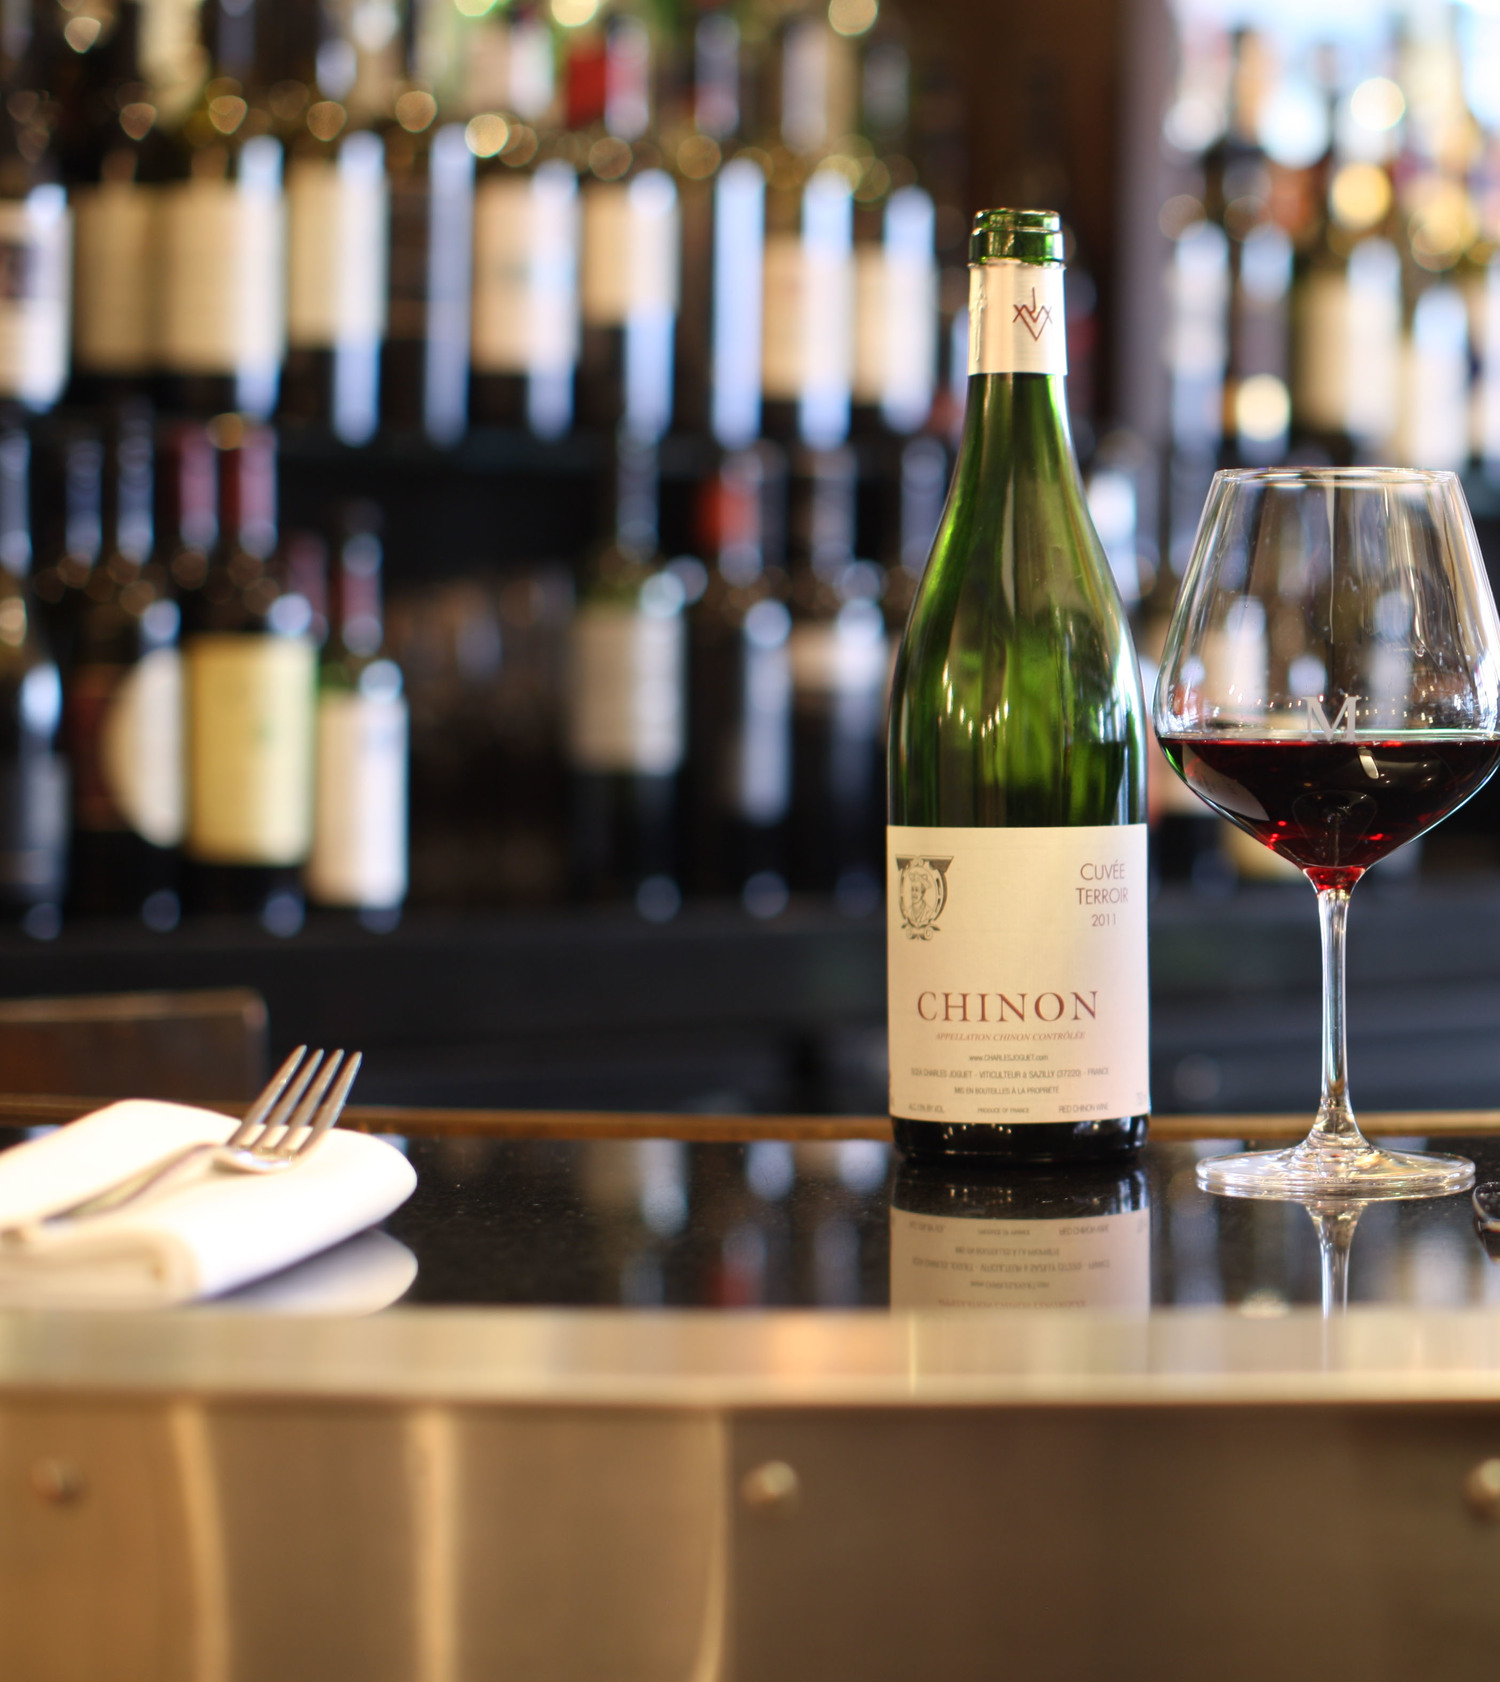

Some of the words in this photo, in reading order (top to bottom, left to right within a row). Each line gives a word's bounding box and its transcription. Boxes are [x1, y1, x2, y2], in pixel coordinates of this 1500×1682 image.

[1301, 696, 1362, 742] M
[1080, 859, 1126, 881] CUVÉE
[1075, 887, 1129, 906] TERROIR
[1091, 913, 1118, 927] 2011
[917, 991, 1099, 1022] CHINON
[936, 1032, 991, 1041] APPELLATION
[993, 1033, 1031, 1042] CHINON
[979, 1070, 1020, 1079] VITICULTEUR
[1029, 1069, 1056, 1079] SAZILLY
[1088, 1067, 1109, 1076] FRANCE
[1058, 1104, 1071, 1113] RED
